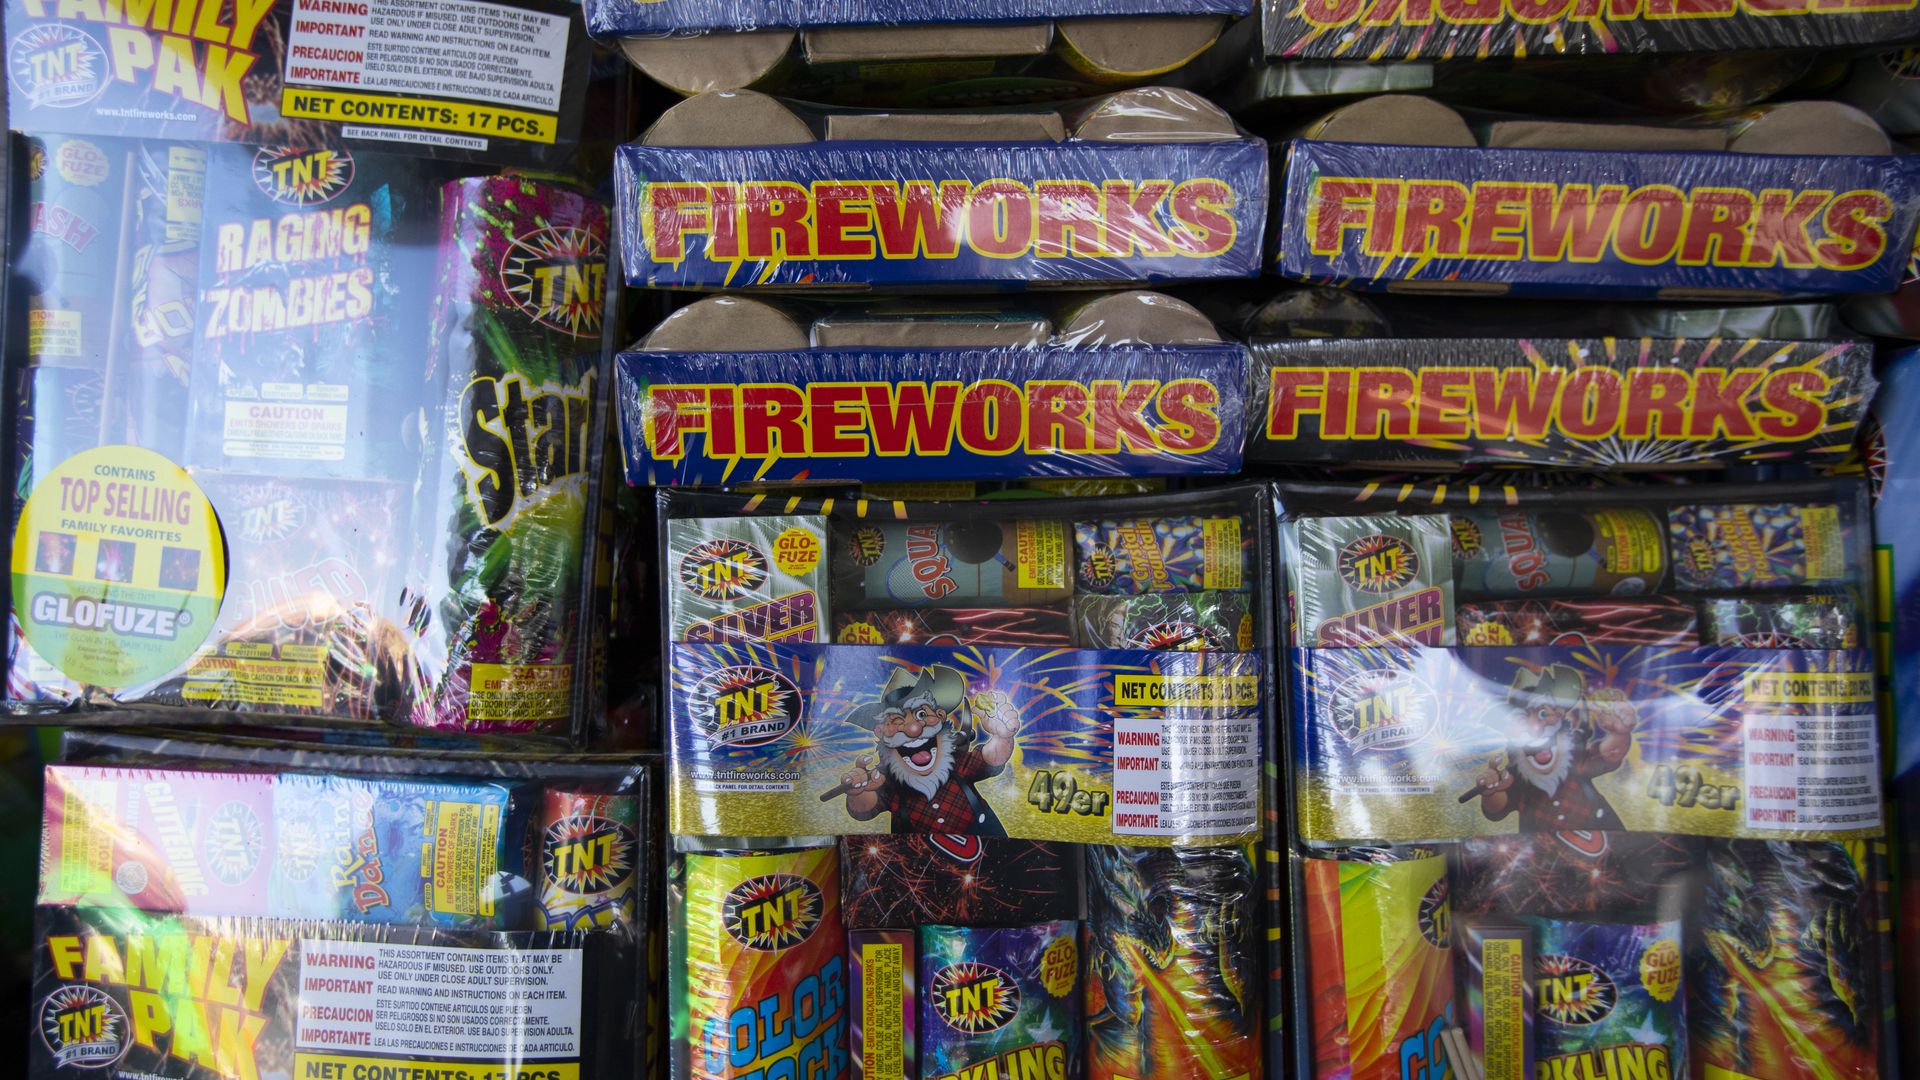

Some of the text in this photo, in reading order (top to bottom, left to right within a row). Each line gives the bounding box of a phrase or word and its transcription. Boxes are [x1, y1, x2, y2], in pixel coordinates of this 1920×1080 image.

[298, 0, 368, 16] WARNING
[371, 8, 416, 19] HAZARDOUS
[460, 15, 475, 24] USE
[477, 18, 519, 30] OUTDOORS
[390, 0, 550, 26] ASSORTMENT CONTAINS ITEMS THAT MAY BE
[296, 20, 365, 38] IMPORTANT
[30, 41, 88, 82] TNT
[292, 45, 364, 63] PRECAUCION
[107, 26, 258, 125] PAK
[291, 66, 361, 84] IMPORTANTE
[96, 107, 196, 121] www.tntfireworks.com
[293, 95, 545, 136] NET CONTENTS: 17 PCS.
[361, 129, 379, 138] BACK
[380, 130, 401, 139] PANEL
[403, 132, 417, 140] FOR
[419, 134, 444, 143] DETAIL
[445, 136, 482, 148] CONTENTS
[61, 160, 105, 176] FUZE
[273, 150, 333, 191] TNT
[648, 179, 1237, 263] FIREWORKS
[1308, 176, 1893, 272] FIREWORKS
[217, 204, 372, 273] RAGING
[534, 263, 606, 308] TNT
[205, 267, 374, 338] ZOMBIES
[250, 405, 324, 420] CAUTION
[648, 378, 1221, 459] FIREWORKS
[1266, 366, 1831, 443] FIREWORKS
[94, 464, 156, 482] CONTAINS
[61, 477, 191, 525] TOP SELLING
[242, 499, 290, 531] TNT
[61, 518, 182, 543] FAMILY FAVORITES
[778, 537, 817, 550] GLO-
[859, 533, 877, 558] TNT
[777, 550, 818, 564] FUZE
[1091, 554, 1111, 579] TNT
[1117, 527, 1149, 581] Crystal
[1354, 547, 1401, 585] TNT
[697, 550, 750, 591] TNT
[684, 590, 817, 643] SILVER
[1318, 587, 1443, 648] SILVER
[715, 681, 774, 729] TNT
[1121, 682, 1147, 699] NET
[1354, 686, 1410, 733] TNT
[721, 721, 786, 741] #1 BRAND
[1118, 732, 1160, 746] WARNING
[1117, 756, 1159, 771] IMPORTANT
[1028, 770, 1109, 817] 49er
[1116, 790, 1159, 805] PRECAUCION
[1648, 765, 1741, 811] 49er
[449, 812, 457, 838] SPARKS
[1116, 813, 1159, 829] IMPORTANTE
[145, 781, 208, 896] GLITTERING
[217, 816, 249, 875] TNT
[332, 798, 362, 891] Rain
[354, 787, 389, 914] Dance
[555, 831, 619, 878] TNT
[436, 827, 447, 889] CAUTION
[742, 888, 803, 938] TNT
[306, 952, 375, 970] WARNING
[378, 960, 423, 971] HAZARDOUS
[433, 962, 467, 973] MISUSED.
[469, 965, 484, 974] USE
[532, 966, 554, 974] ONLY.
[380, 949, 508, 963] THIS ASSORTMENT CONTAINS ITEMS
[533, 955, 562, 963] MAY BE
[1046, 960, 1075, 983] FUZE
[49, 935, 290, 1012] FAMILY
[304, 977, 373, 994] IMPORTANT
[378, 971, 548, 986] USE ONLY UNDER CLOSE ADULT SUPERVISION.
[1511, 953, 1520, 997] CAUTION
[1535, 973, 1592, 1006] TNT
[1646, 966, 1680, 985] FUZE
[377, 985, 567, 1000] READ WARNING AND INSTRUCTIONS ON EACH ITEM.
[866, 958, 874, 1026] CRACKLING SPARKS
[946, 978, 999, 1018] TNT
[58, 1004, 105, 1042] TNT
[302, 1005, 373, 1023] PRECAUCION
[884, 947, 892, 1075] USE ONLY NOT HOLD PLACE
[893, 965, 901, 1077] LEVEL LIGHT FUSE AND GET
[129, 989, 270, 1080] PAK
[301, 1028, 371, 1046] IMPORTANTE
[374, 1038, 448, 1051] LEA LAS PRECAUCIONES
[65, 1046, 116, 1059] #1 BRAND
[306, 1061, 347, 1080] NET
